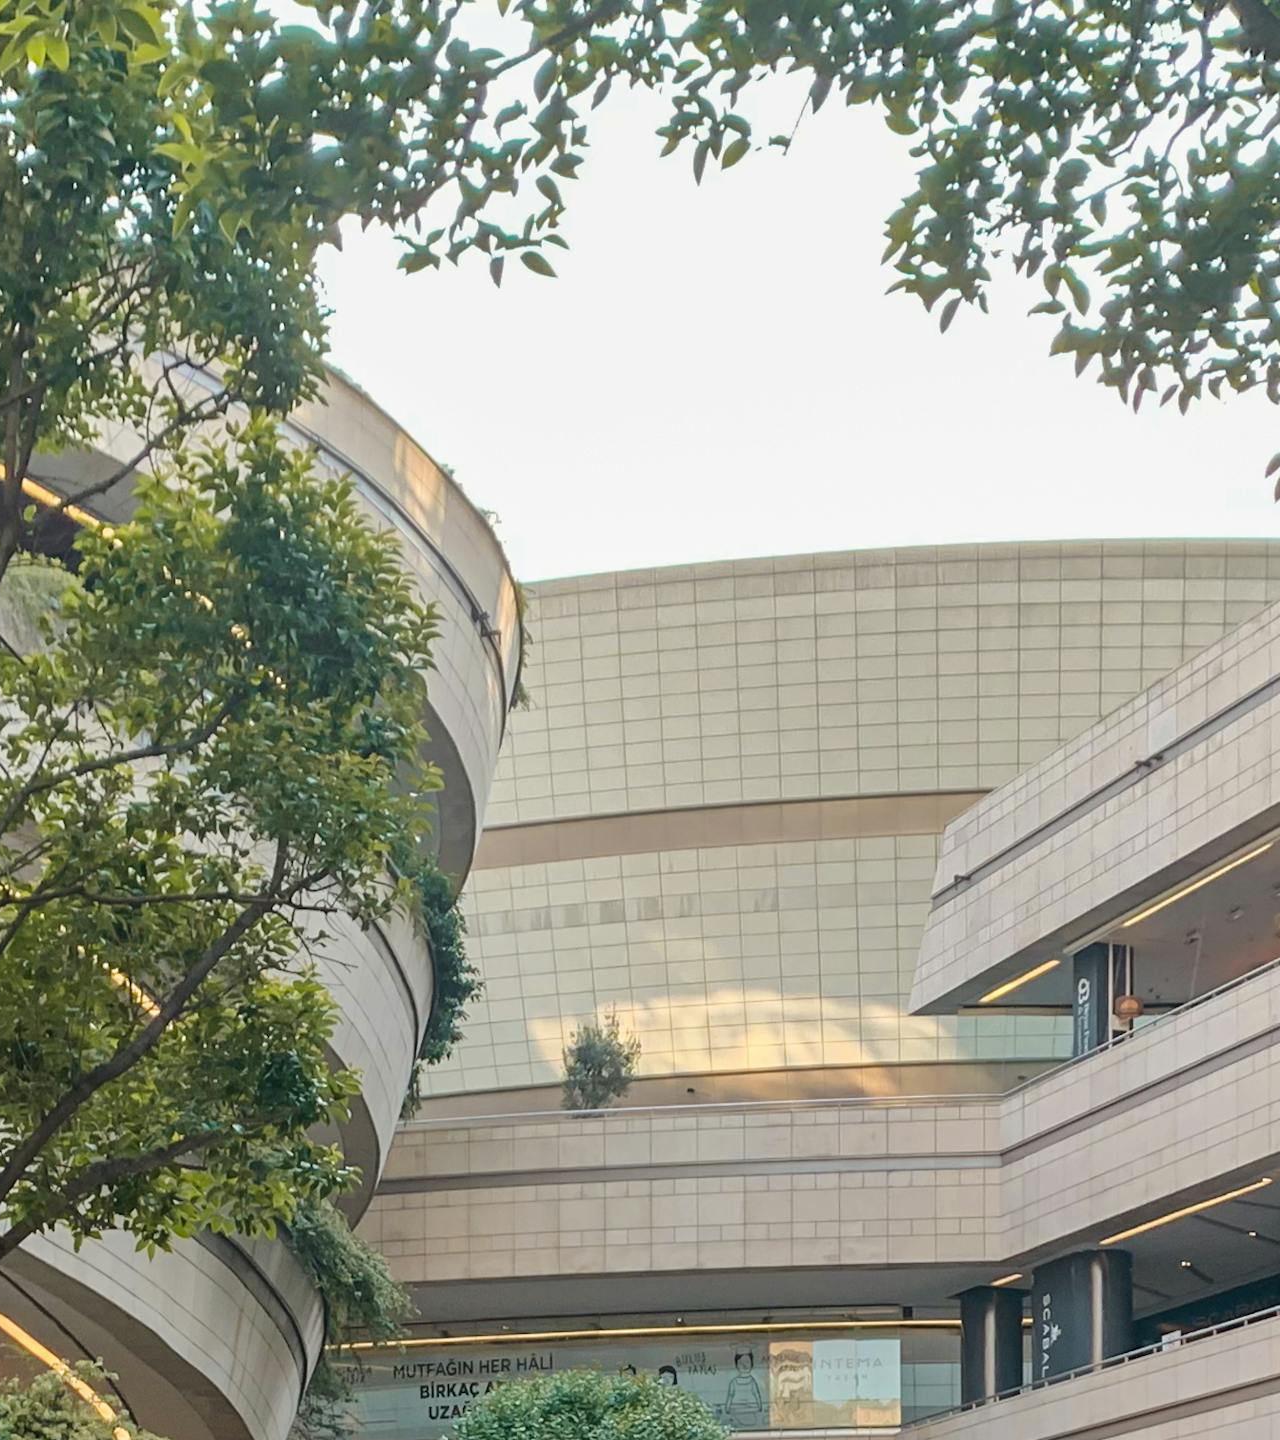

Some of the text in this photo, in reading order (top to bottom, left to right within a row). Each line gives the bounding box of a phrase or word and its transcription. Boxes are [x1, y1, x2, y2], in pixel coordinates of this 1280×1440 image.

[393, 1358, 474, 1380] MUTFAĞIN
[479, 1358, 511, 1373] HER
[516, 1352, 553, 1370] HÂLİ
[420, 1380, 480, 1400] BİRKAÇ
